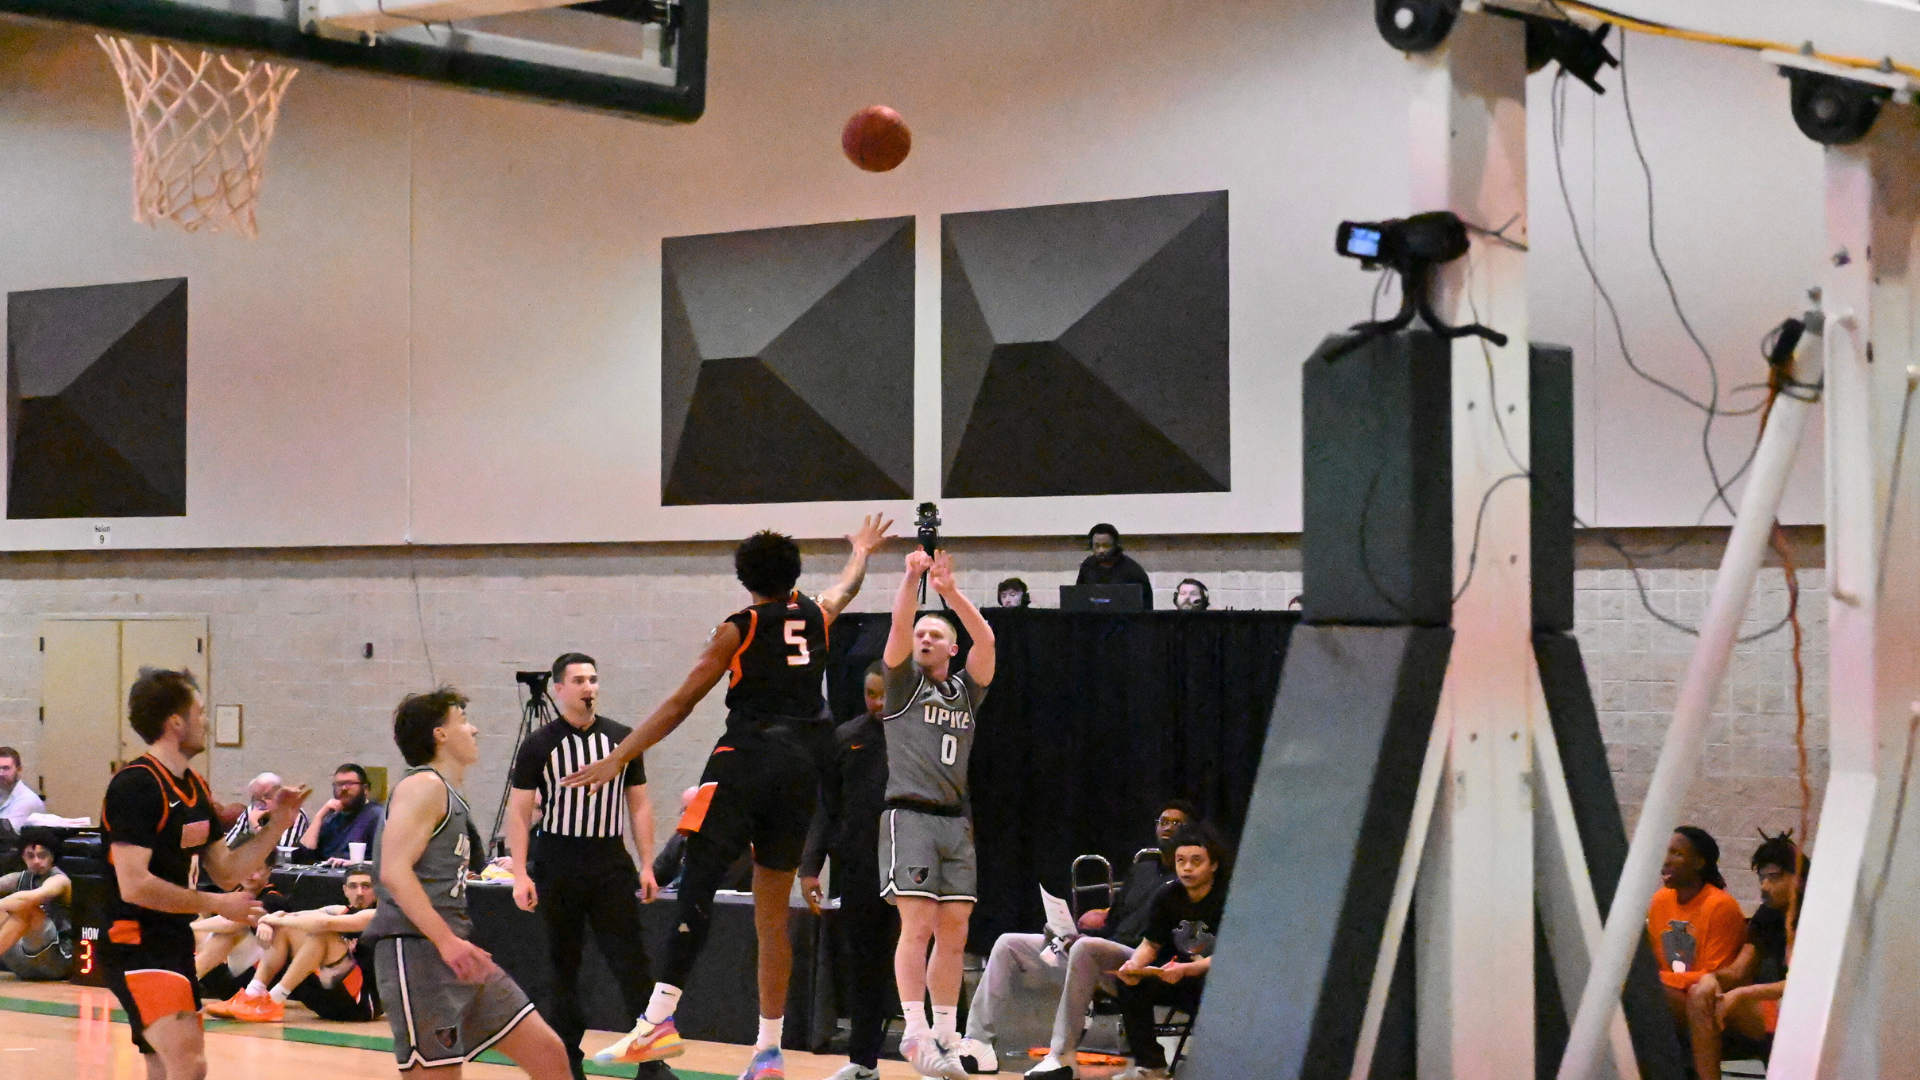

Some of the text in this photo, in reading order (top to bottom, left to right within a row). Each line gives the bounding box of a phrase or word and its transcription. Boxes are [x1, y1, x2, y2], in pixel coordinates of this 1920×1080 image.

[783, 619, 811, 666] 5
[940, 733, 958, 766] 0
[80, 939, 92, 974] 3
